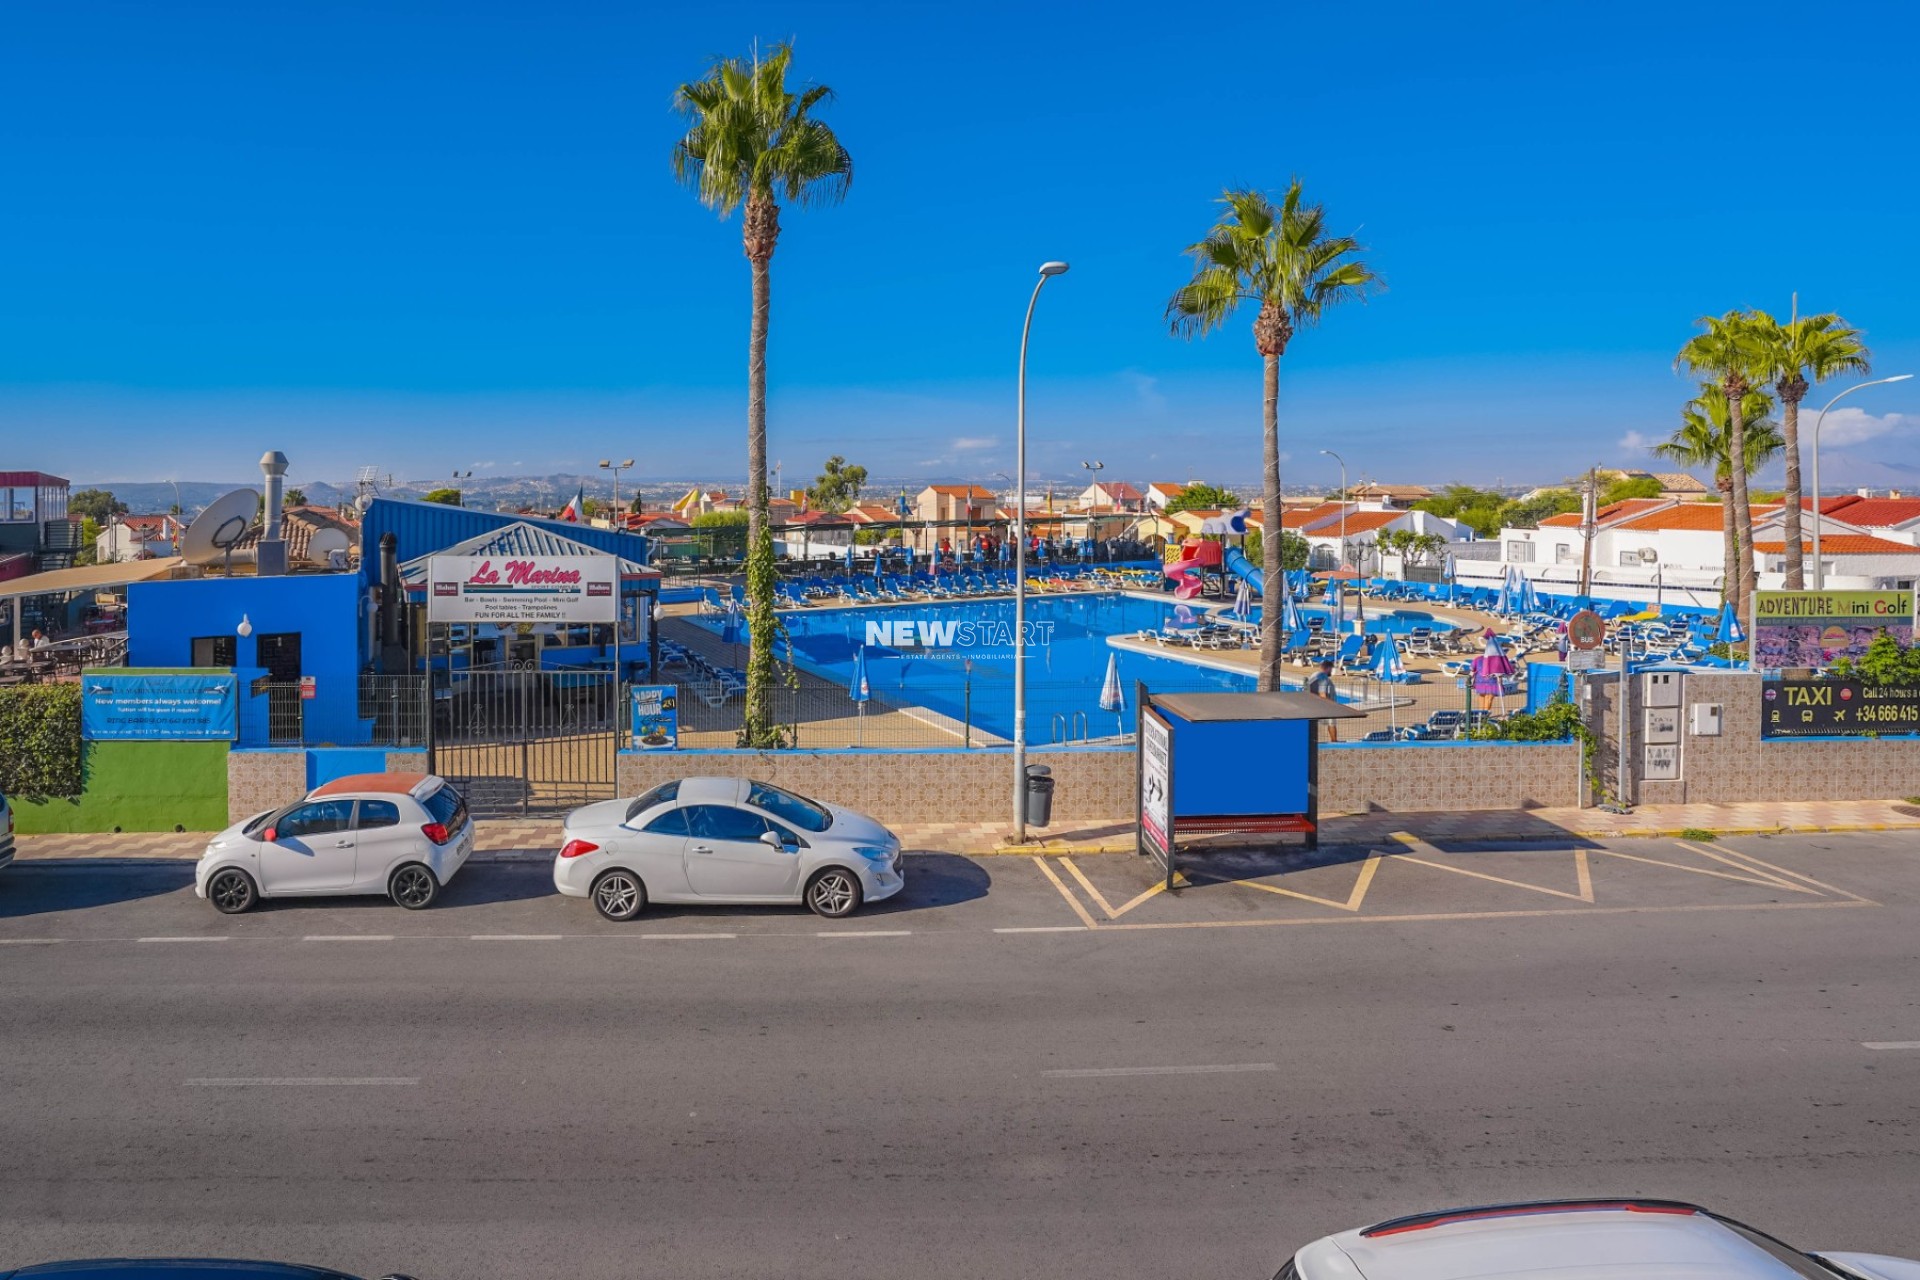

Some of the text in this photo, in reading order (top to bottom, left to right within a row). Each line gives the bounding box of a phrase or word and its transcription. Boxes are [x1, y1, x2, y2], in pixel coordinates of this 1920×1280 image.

[469, 559, 582, 584] La Marina
[1758, 593, 1907, 616] ADVENTURE Mini Golf
[154, 698, 181, 706] always
[634, 690, 663, 703] HAPPY
[1783, 686, 1833, 706] TAXI
[1862, 686, 1878, 699] Call
[1878, 687, 1888, 699] 24
[1889, 687, 1912, 699] hours
[638, 704, 662, 716] HOUR
[1855, 704, 1919, 722] +34 666 415
